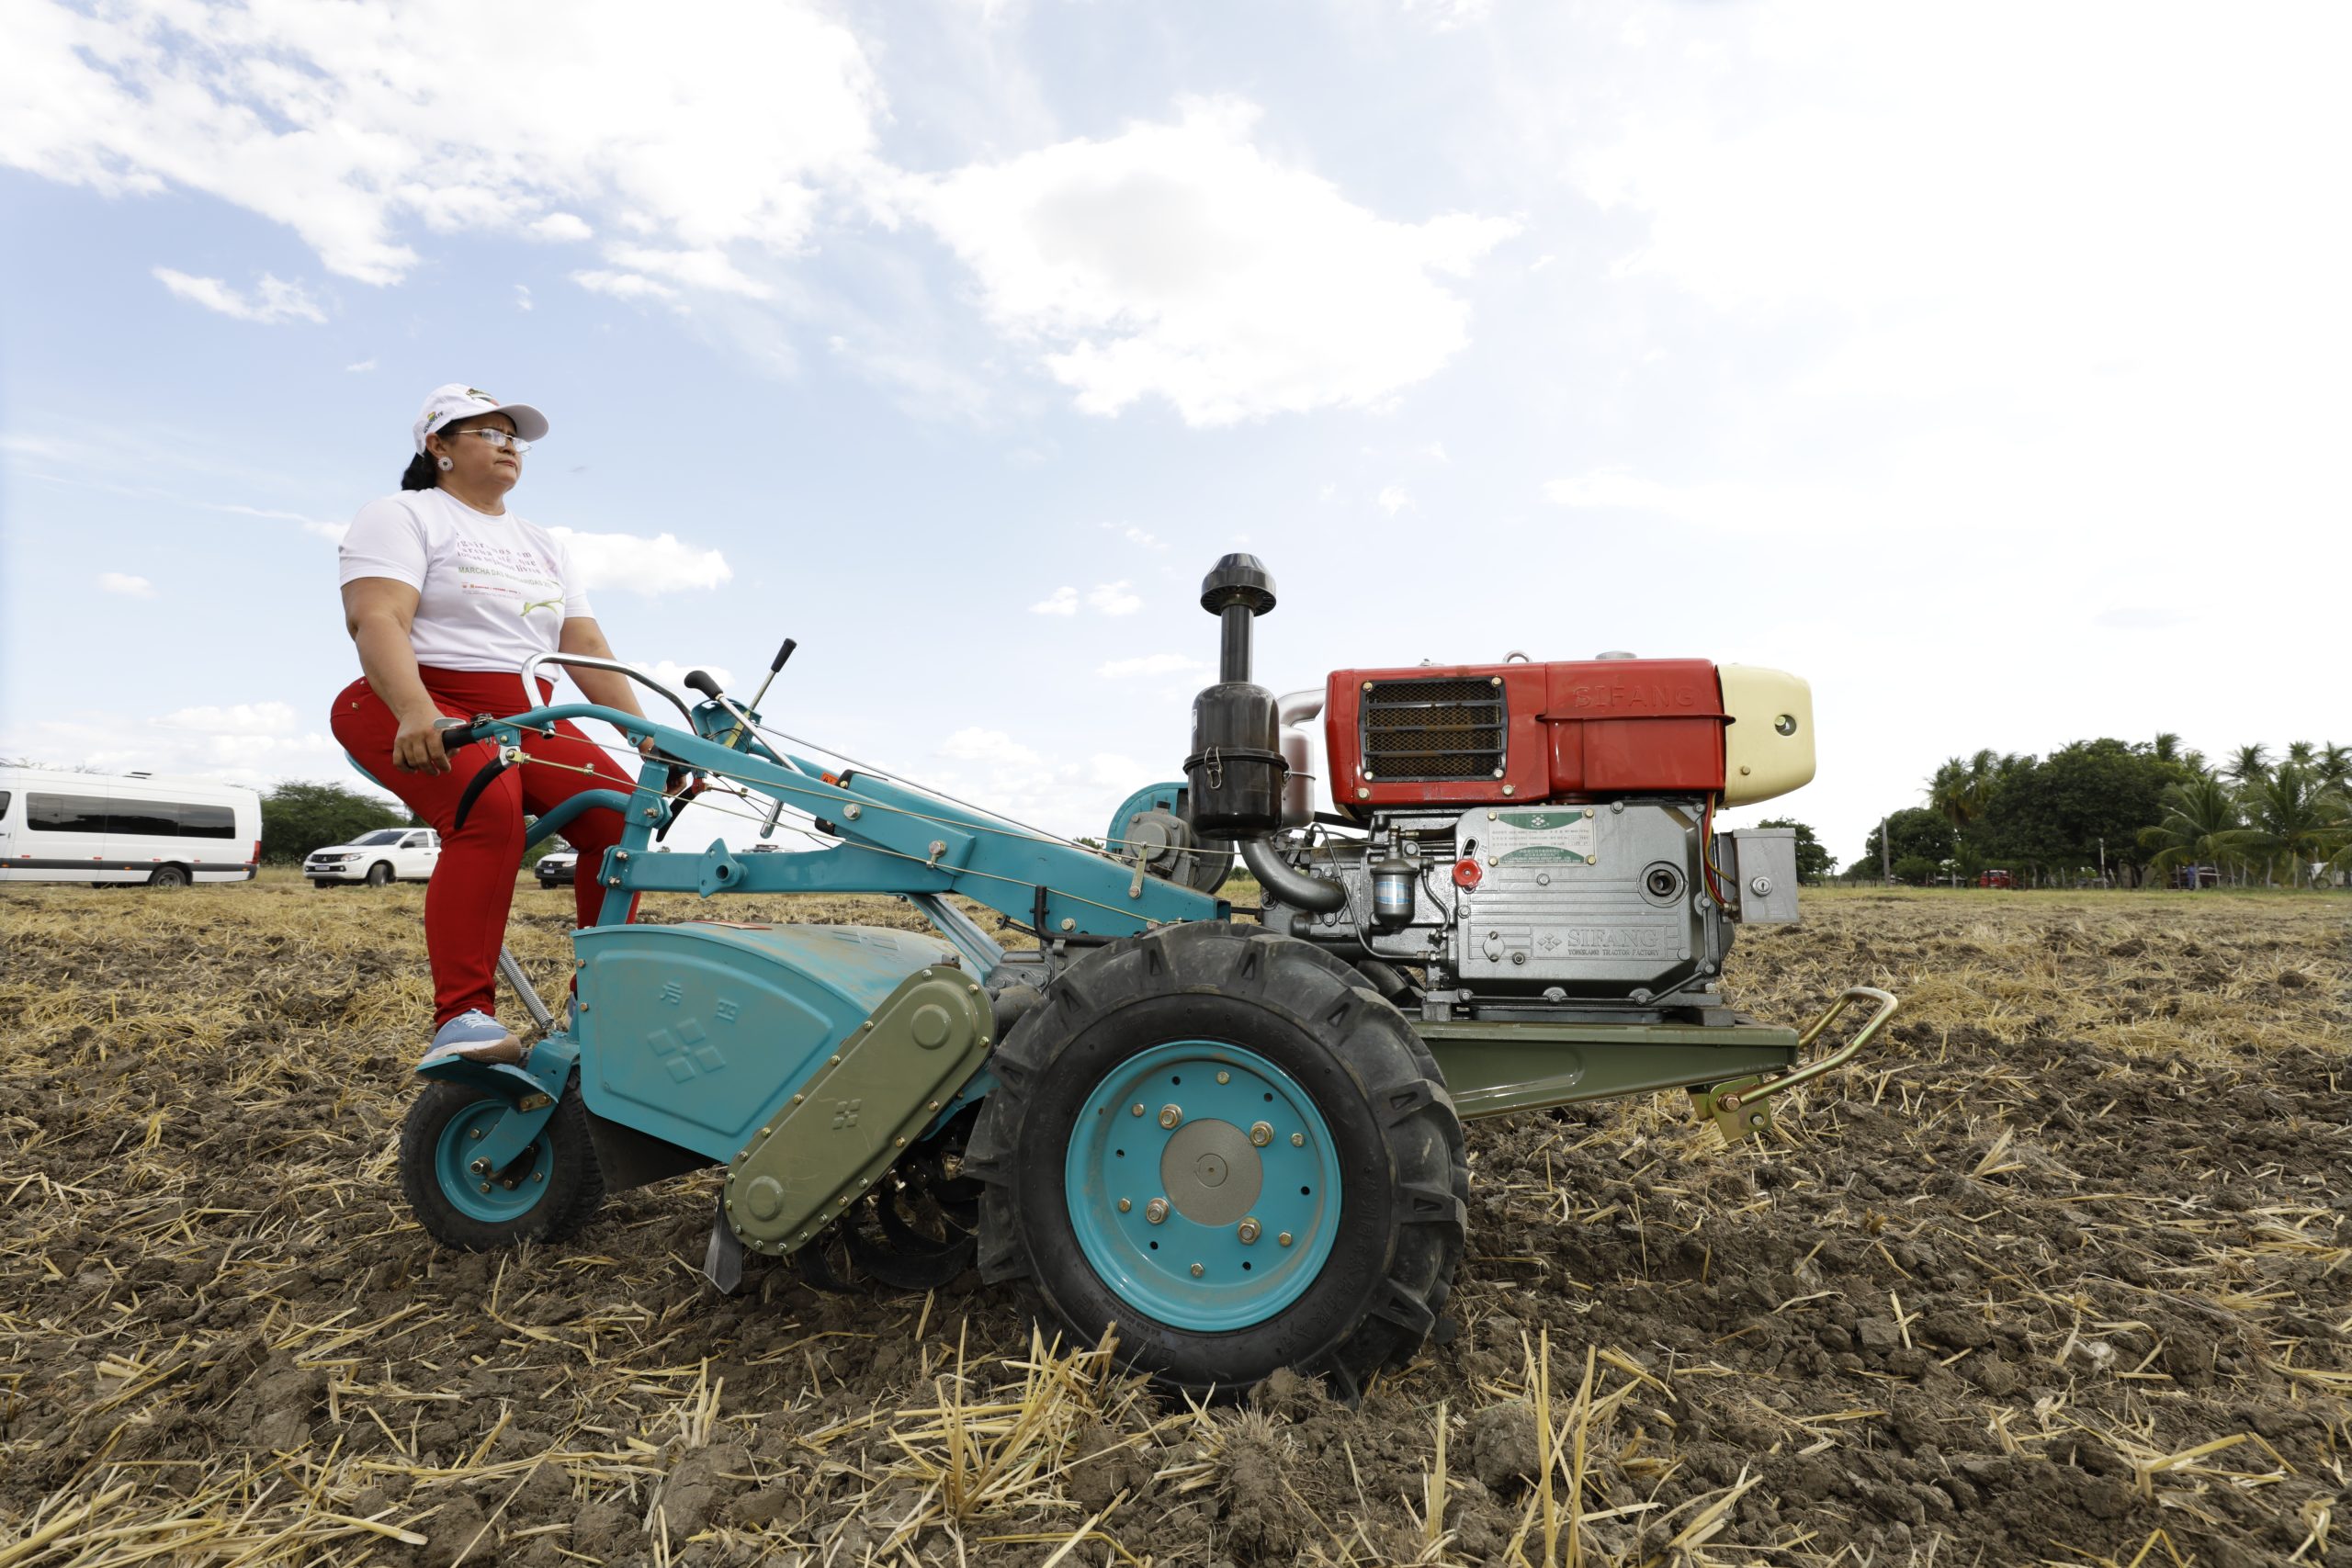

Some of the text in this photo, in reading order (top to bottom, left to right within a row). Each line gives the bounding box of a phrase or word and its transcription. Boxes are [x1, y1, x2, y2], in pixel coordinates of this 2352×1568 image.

[458, 566, 492, 577] MARCHA
[1573, 685, 1695, 708] SIFANG
[1567, 928, 1659, 948] SIFANG
